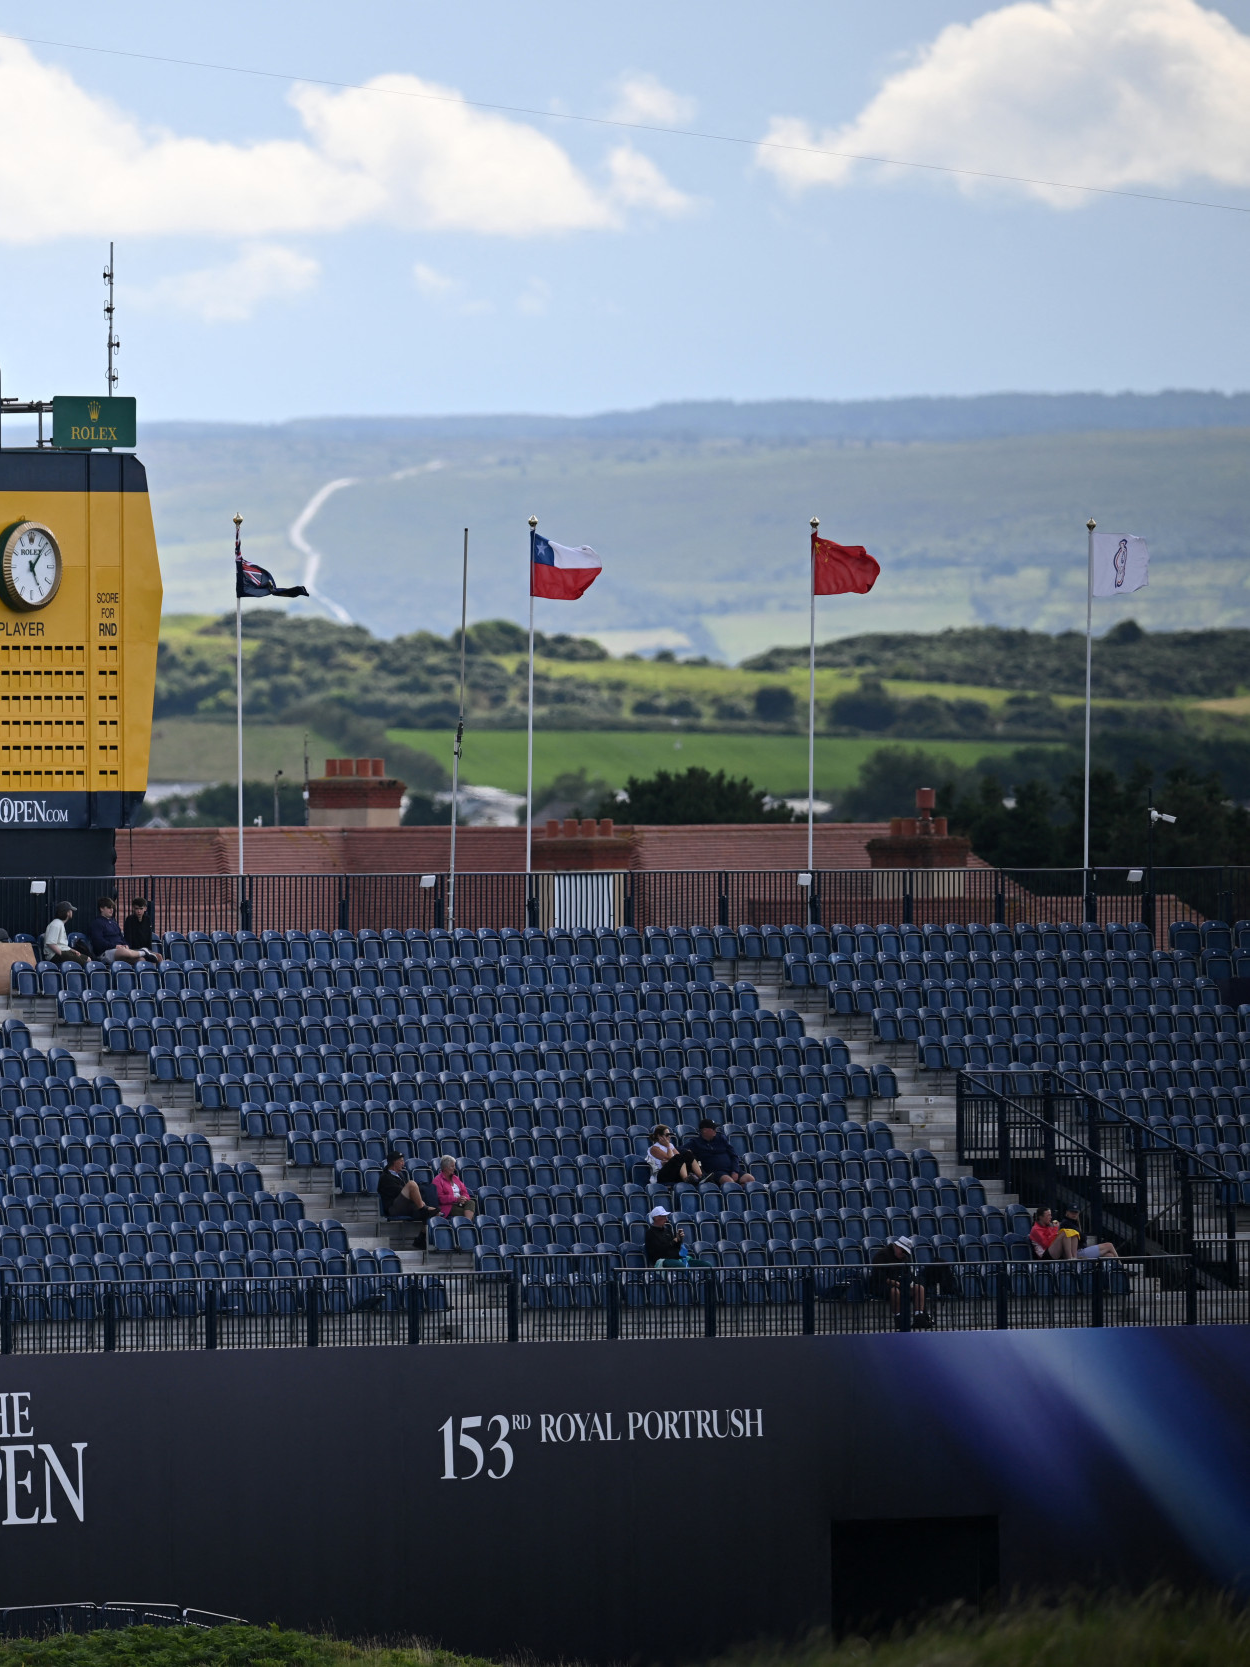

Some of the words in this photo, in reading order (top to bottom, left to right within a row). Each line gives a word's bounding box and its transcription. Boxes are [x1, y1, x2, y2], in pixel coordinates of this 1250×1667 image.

[71, 426, 118, 441] ROLEX
[96, 592, 119, 604] SCORE
[101, 607, 115, 619] FOR
[98, 622, 118, 637] RND
[437, 1413, 532, 1480] 153RD
[539, 1412, 621, 1443] ROYAL
[627, 1408, 764, 1441] PORTRUSH
